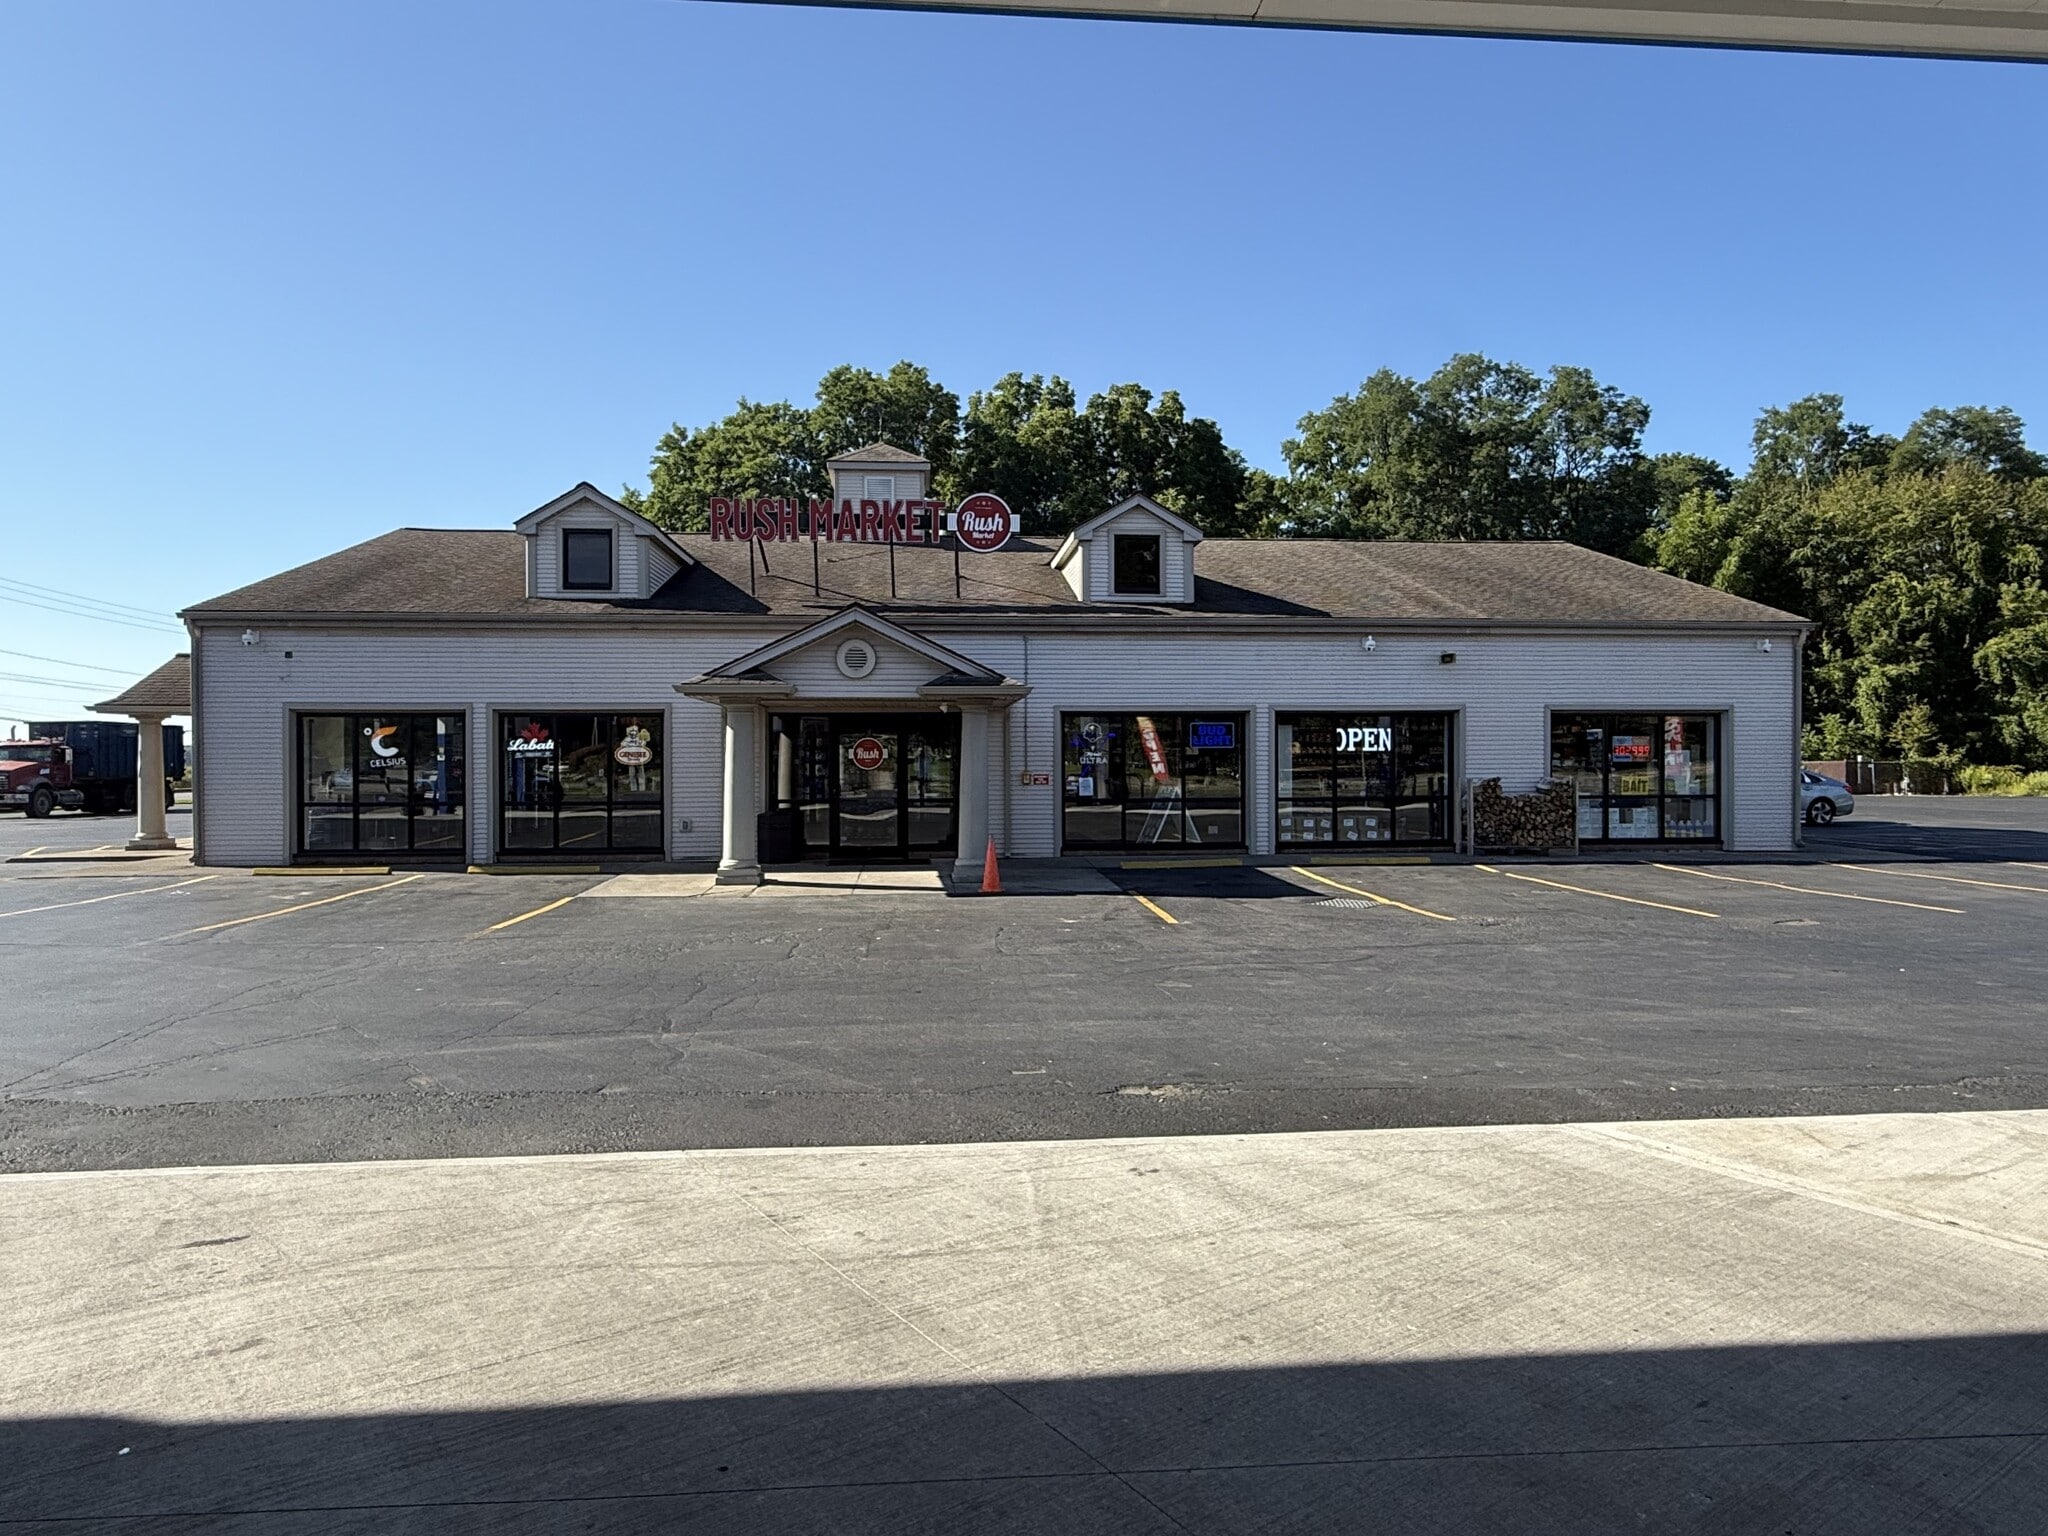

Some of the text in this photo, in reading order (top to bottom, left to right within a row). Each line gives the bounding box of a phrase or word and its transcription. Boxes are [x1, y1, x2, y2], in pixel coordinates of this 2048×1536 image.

[710, 497, 946, 543] RUSH MARKET
[962, 511, 1003, 531] Rush
[1198, 725, 1226, 735] BUD
[1193, 735, 1231, 746] LIGHT
[856, 747, 879, 759] Rush
[370, 757, 406, 768] CELSIUS
[1622, 779, 1648, 793] BAIT
